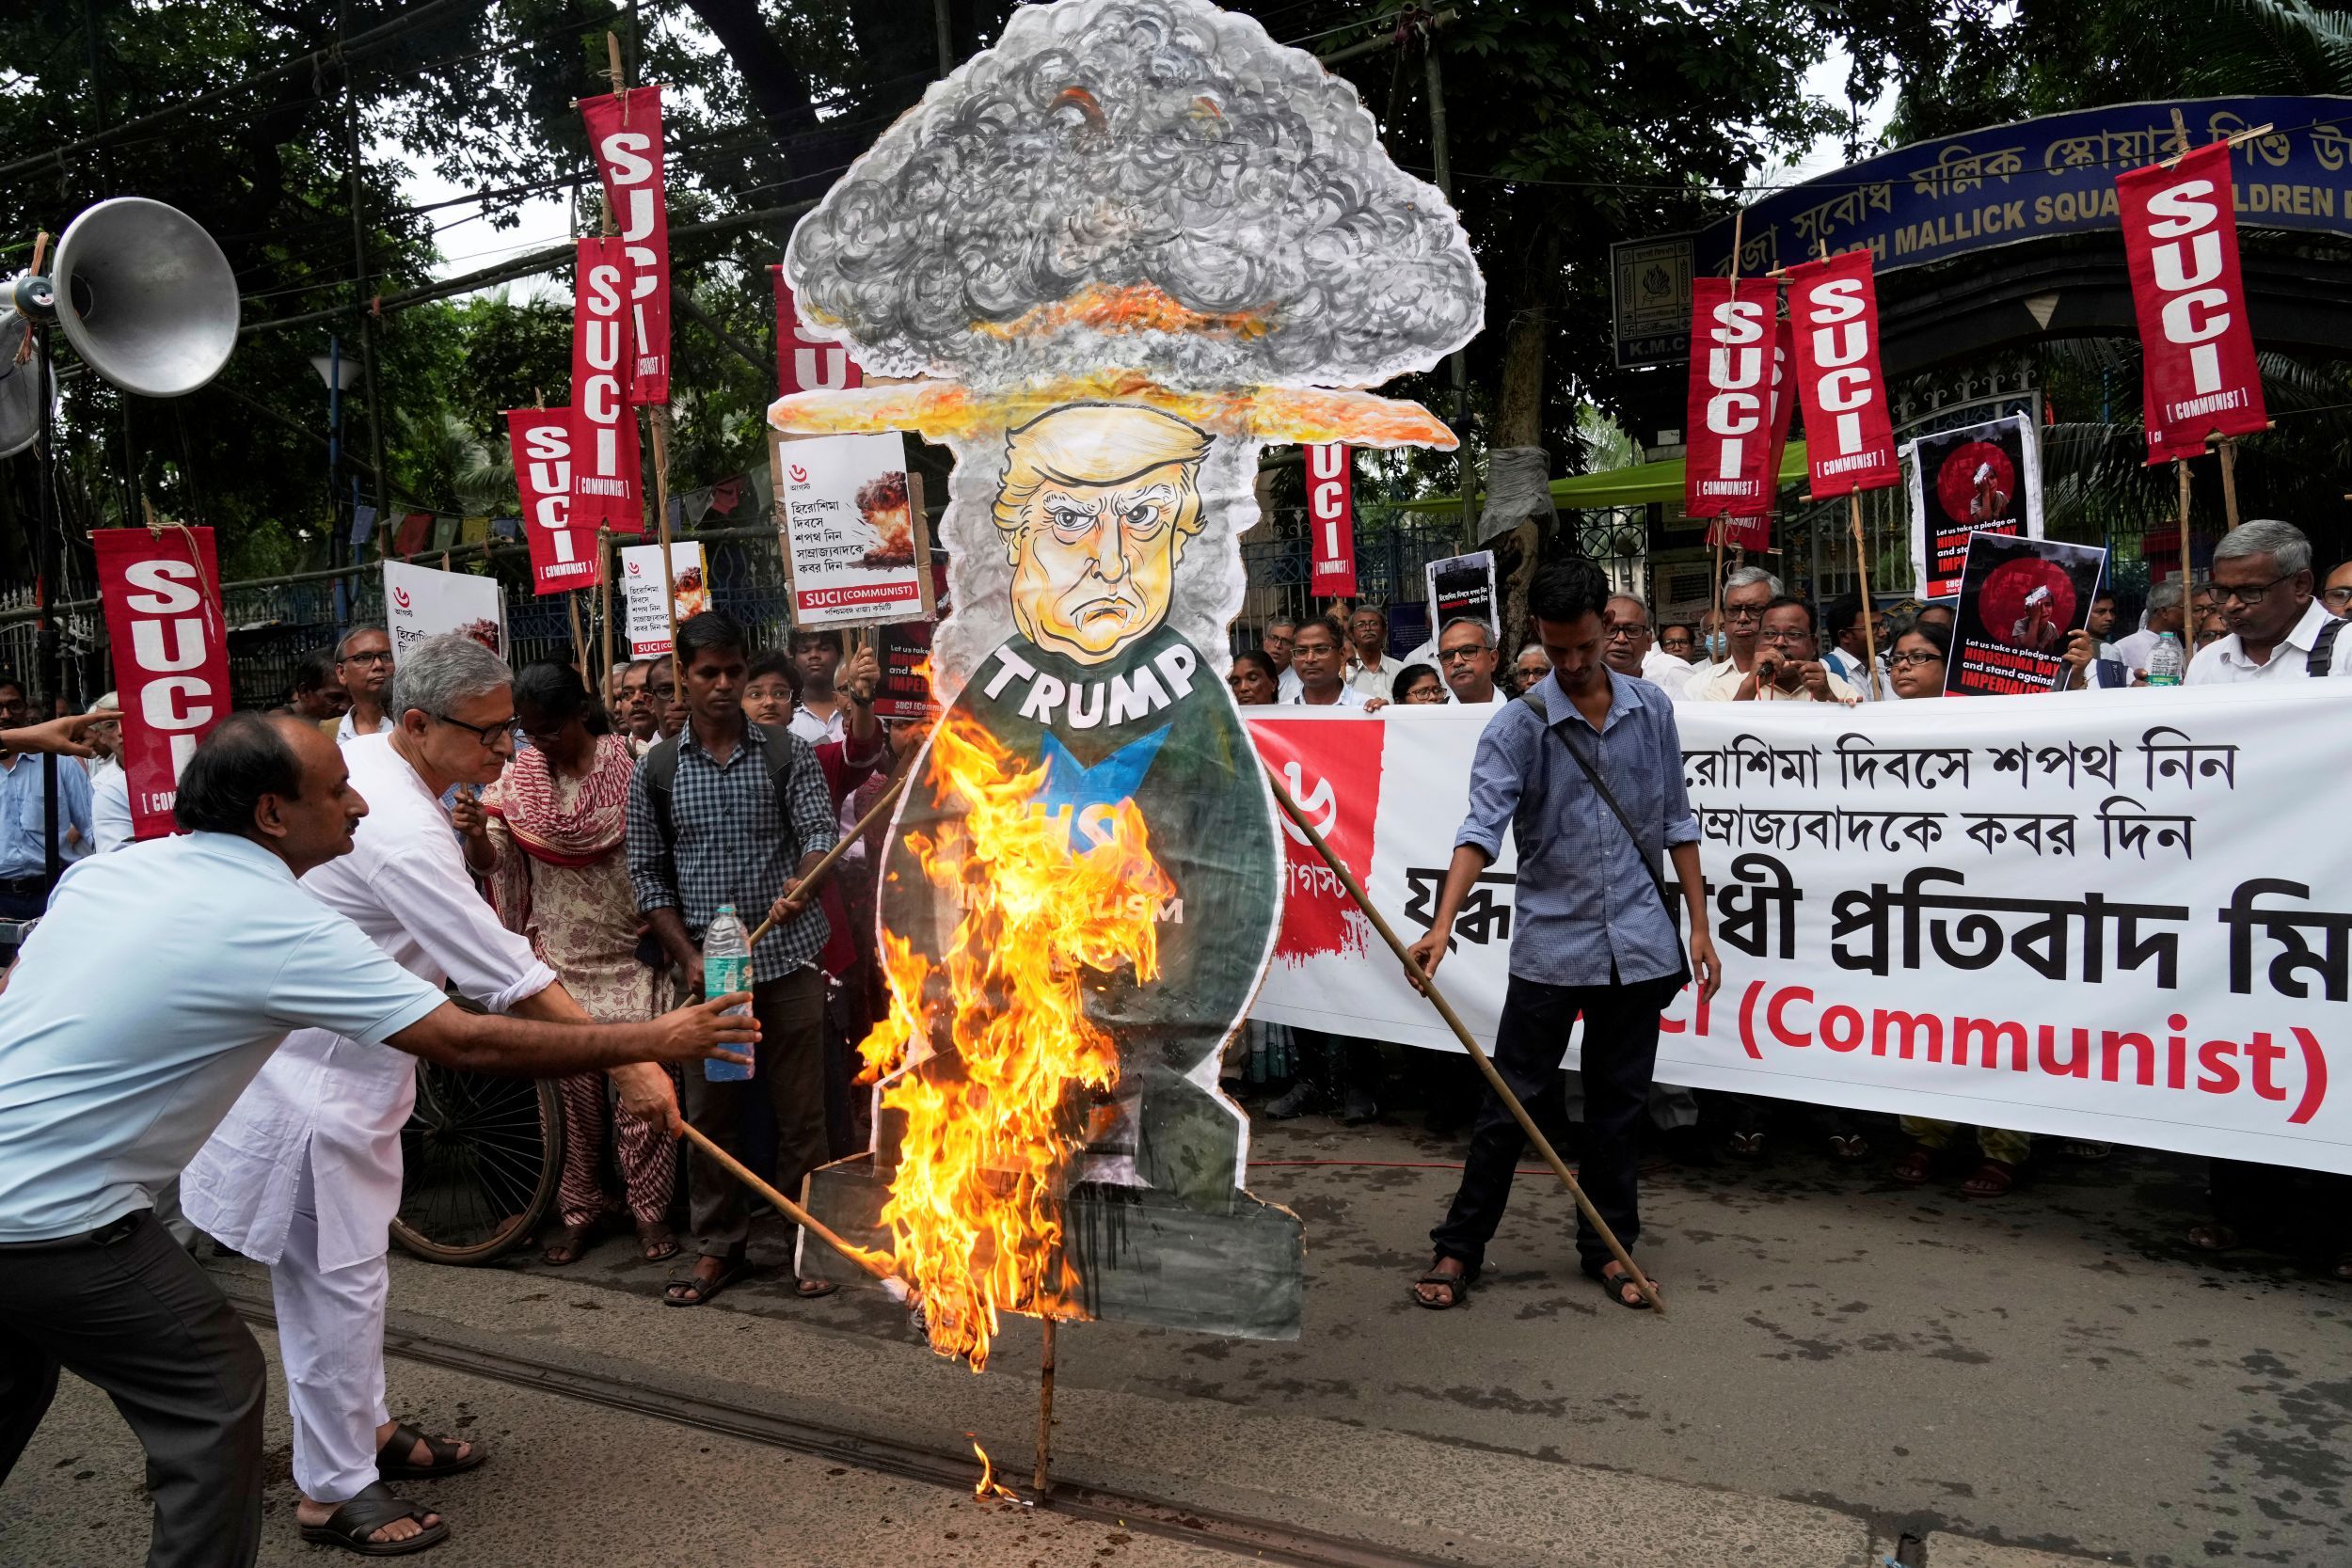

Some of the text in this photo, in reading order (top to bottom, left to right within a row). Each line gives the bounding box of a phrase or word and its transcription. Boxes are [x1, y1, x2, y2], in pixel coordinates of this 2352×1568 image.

[1790, 179, 1894, 256] সুবোধ
[1908, 145, 2026, 199] মল্লিক
[1895, 199, 2026, 257] MALLICK
[2034, 187, 2121, 225] SQUA
[2232, 183, 2334, 217] LDREN
[2146, 180, 2231, 396] SUCI
[584, 264, 621, 476] SUCI
[1809, 278, 1872, 455] SUCI
[1707, 301, 1764, 479] SUCI
[788, 464, 807, 483] ৬
[525, 426, 575, 563] SUCI
[790, 499, 840, 515] হিরোশিমা
[1312, 446, 1343, 559] UCI
[792, 516, 824, 530] দিবসে
[795, 529, 843, 544] শপথ নিন
[1979, 519, 2006, 530] pledge
[796, 544, 865, 560] সাম্রাজ্যবাদকে
[798, 559, 843, 574] কবর দিন
[1937, 546, 1955, 557] and
[393, 586, 410, 608] ৬
[805, 585, 913, 606] SUCI (COMMUNIST)
[633, 613, 670, 623] সাম্রাজ্যবাদে
[638, 643, 660, 653] SUCI
[913, 646, 930, 655] take
[1963, 647, 2060, 677] HIROSHIMA DAY
[1965, 638, 1979, 647] Let
[1979, 641, 1990, 649] us
[1991, 643, 2010, 653] take
[2019, 649, 2050, 661] pledge
[2050, 655, 2062, 663] on
[125, 560, 214, 786] SUCI
[889, 666, 909, 674] and
[983, 642, 1198, 730] TRUMP
[1963, 661, 2056, 687] and stand against
[1681, 725, 2241, 792] রোশিমা দিবসে শপথ নিন
[1279, 761, 1337, 847] ৬
[1691, 795, 2198, 861] াম্রাজ্যবাদকে কবর দিন
[1286, 858, 1352, 898] গস্ট
[956, 882, 1184, 924] IMLISM
[1831, 866, 2189, 990] প্রতিবাদ
[1738, 978, 2328, 1125] (Communist)
